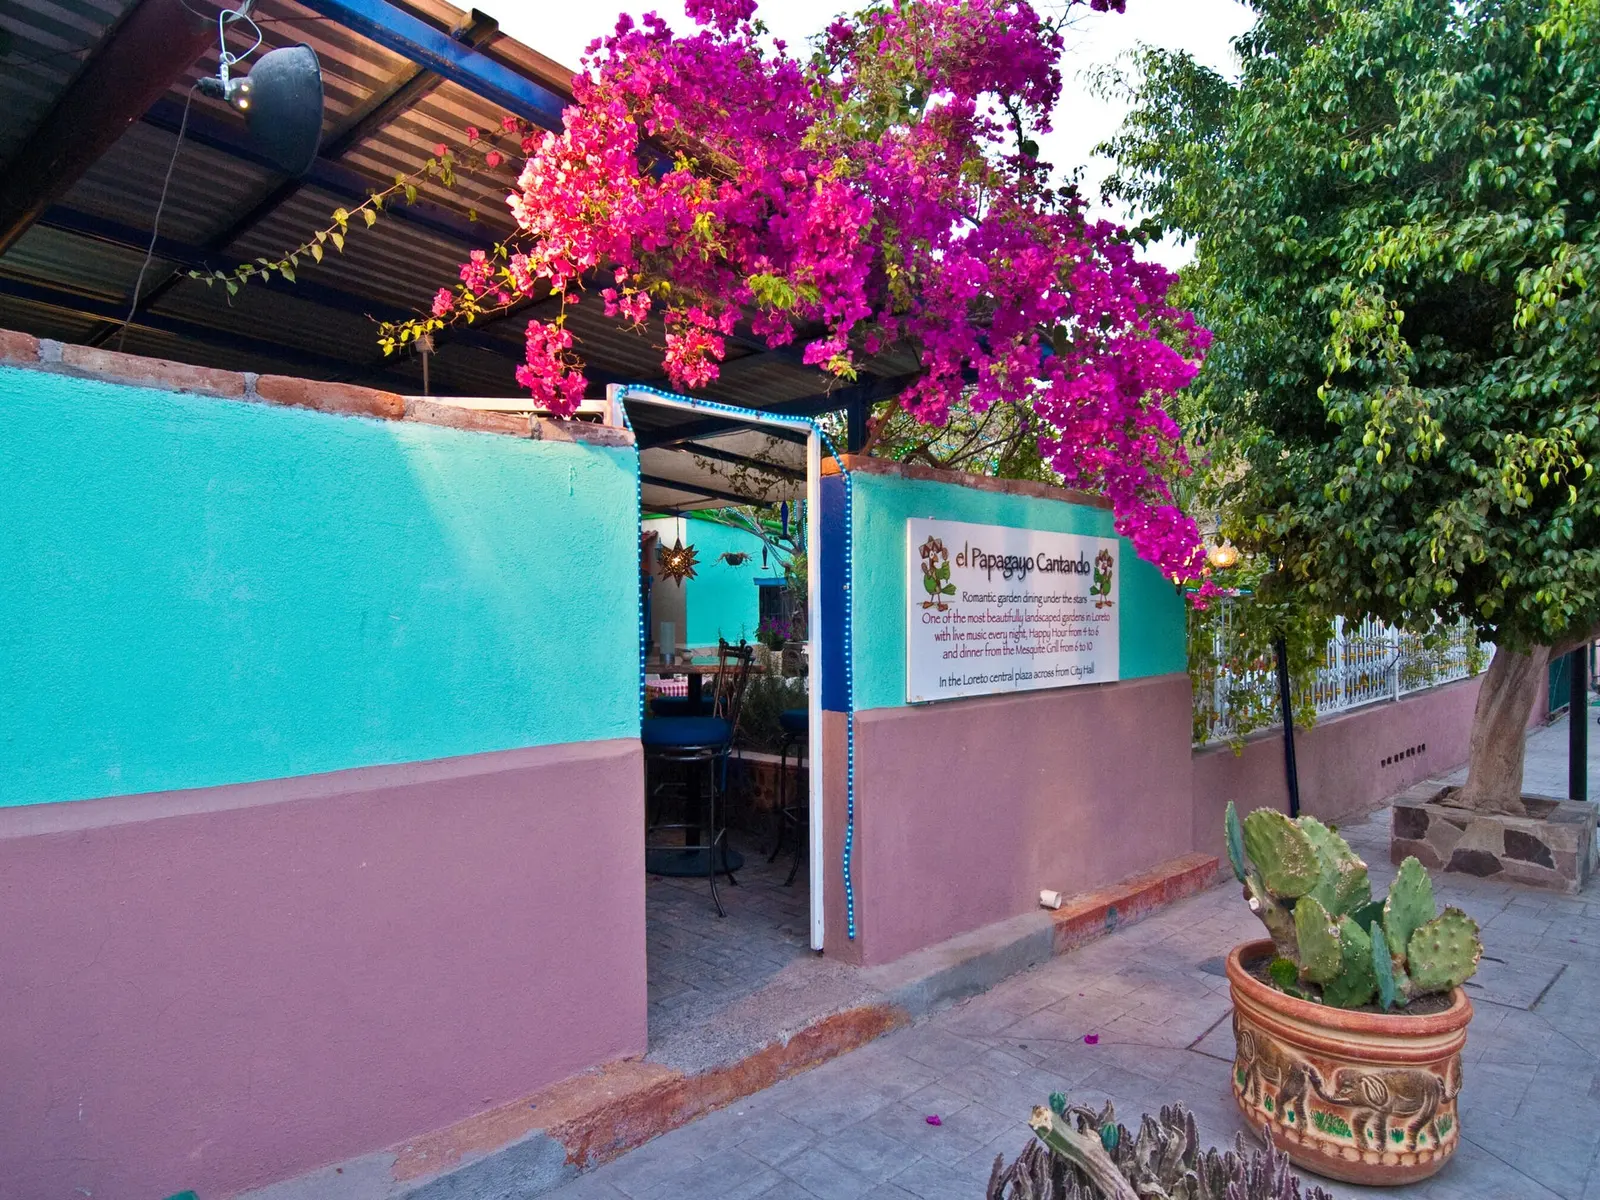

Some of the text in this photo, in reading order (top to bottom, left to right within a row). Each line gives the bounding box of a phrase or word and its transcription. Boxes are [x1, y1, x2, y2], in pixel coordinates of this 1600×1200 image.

[956, 540, 1091, 582] el Papagayo Cantando
[962, 589, 1088, 608] Romantic garden dining under the stars
[922, 608, 1110, 628] One of the most beautifully landscaped gardens in Loreto
[934, 626, 951, 641] with
[952, 626, 965, 641] live
[966, 628, 987, 640] music
[988, 631, 1008, 645] every
[1029, 628, 1051, 643] Happy
[1052, 628, 1067, 637] Hour
[1068, 624, 1082, 637] from
[1088, 627, 1094, 636] to
[1095, 626, 1099, 636] 6
[942, 639, 1093, 660] and dinner from the Mesquite Grill from 6 to 10
[939, 661, 1094, 687] In the Loreto central plaza across from City Hall
